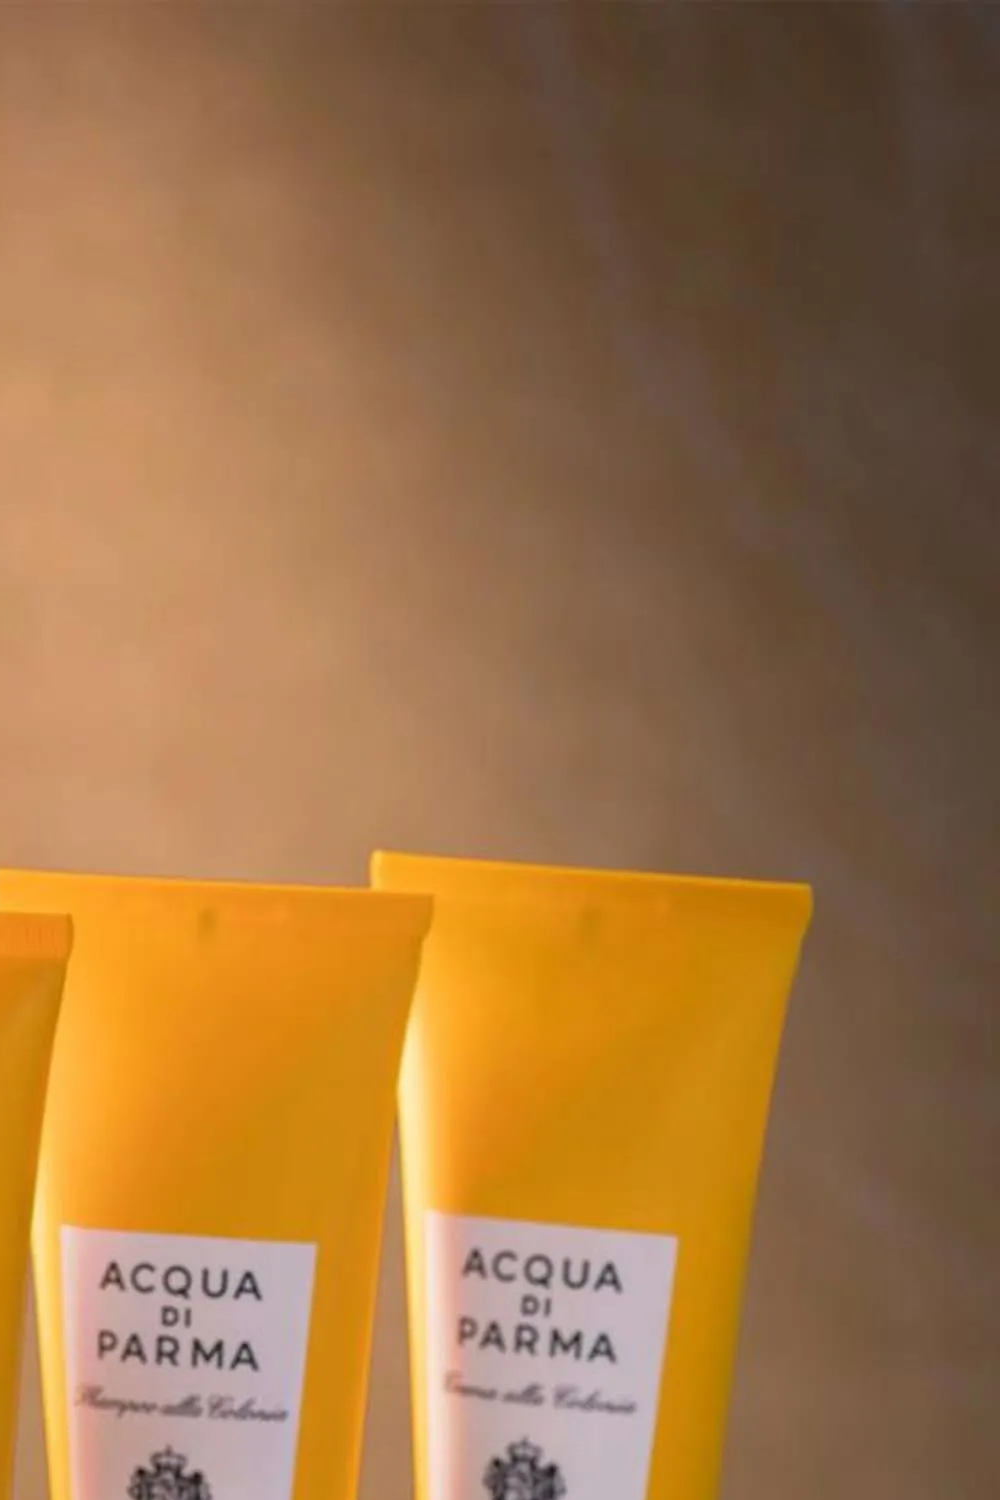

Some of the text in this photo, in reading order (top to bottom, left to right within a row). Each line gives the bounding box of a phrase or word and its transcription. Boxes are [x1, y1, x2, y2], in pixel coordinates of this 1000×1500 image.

[99, 1261, 263, 1301] ACQUA
[462, 1248, 623, 1293] ACQUA
[161, 1306, 192, 1328] DI
[520, 1295, 551, 1317] DI
[97, 1330, 260, 1372] PARMA
[457, 1317, 617, 1363] PARMA
